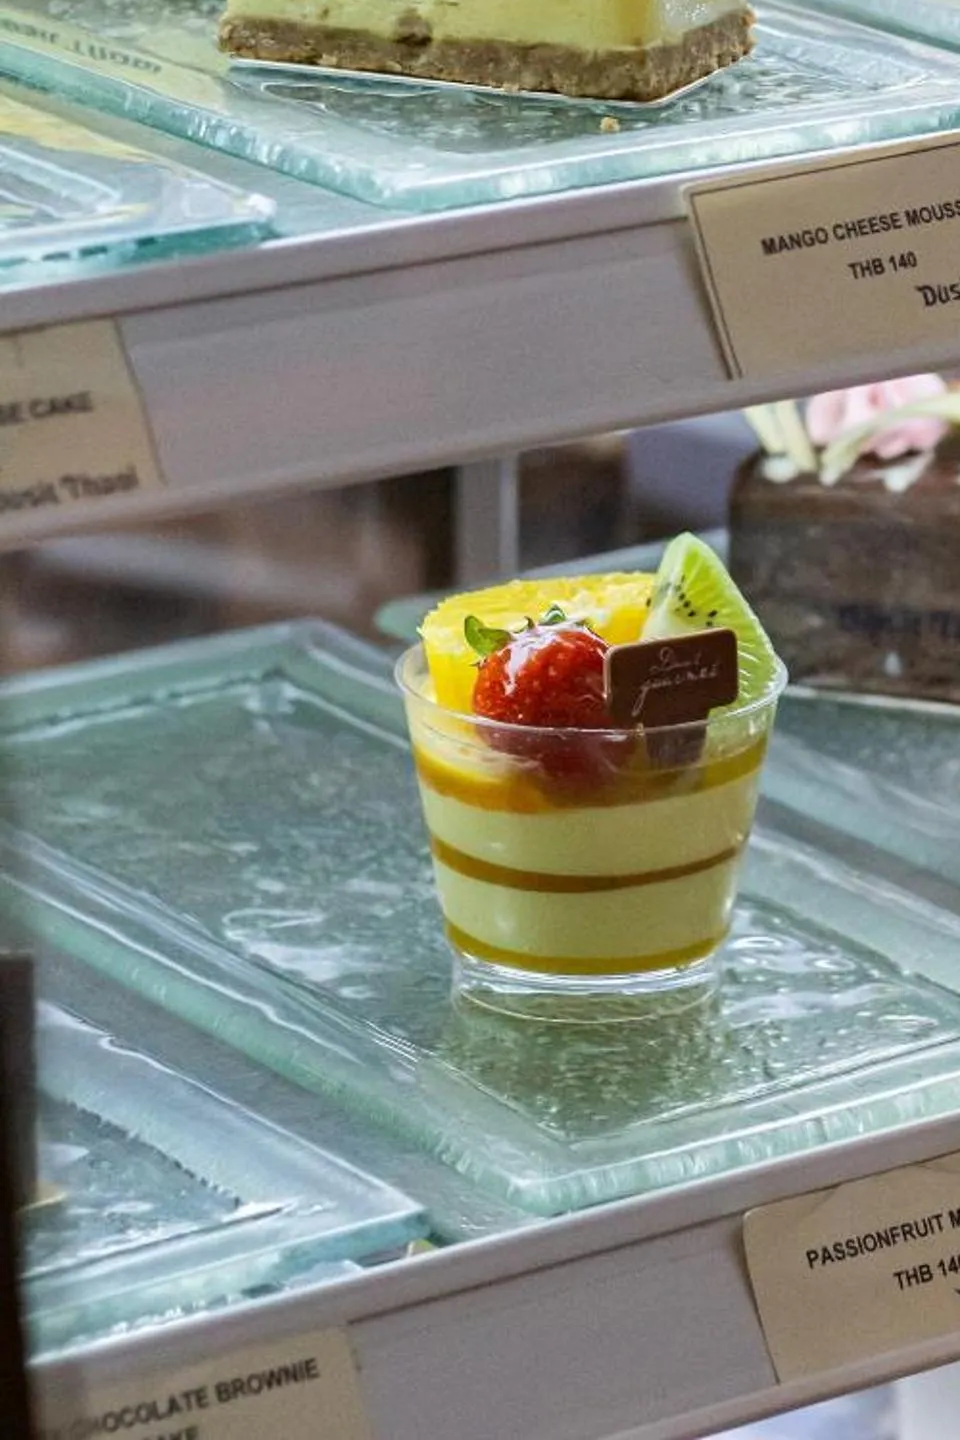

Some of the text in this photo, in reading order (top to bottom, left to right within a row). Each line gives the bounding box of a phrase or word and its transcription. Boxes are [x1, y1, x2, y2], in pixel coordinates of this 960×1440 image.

[761, 226, 828, 256] MANGO
[832, 212, 903, 241] CHEESE
[848, 251, 918, 280] THB 140
[806, 1213, 944, 1269] PASSIONFRUIT
[893, 1264, 934, 1291] THB
[214, 1358, 320, 1404] BROWNIE
